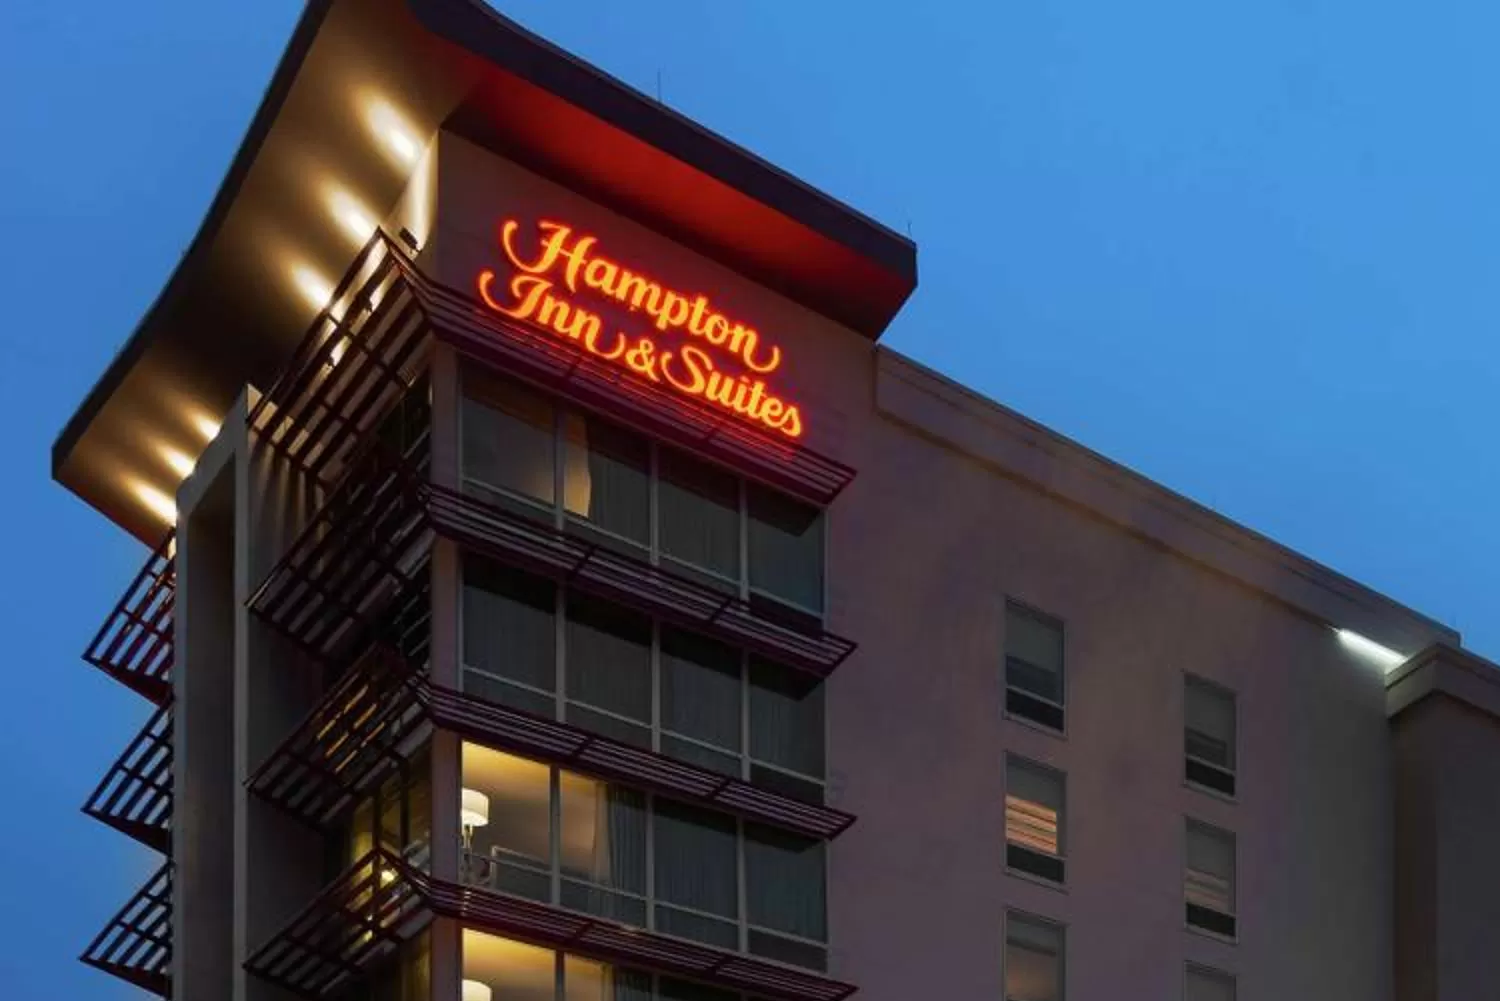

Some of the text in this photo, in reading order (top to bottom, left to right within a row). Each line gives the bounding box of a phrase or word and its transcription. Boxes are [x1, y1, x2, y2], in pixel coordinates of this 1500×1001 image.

[478, 270, 803, 438] Inn & Suites
[503, 218, 780, 373] Hampton
